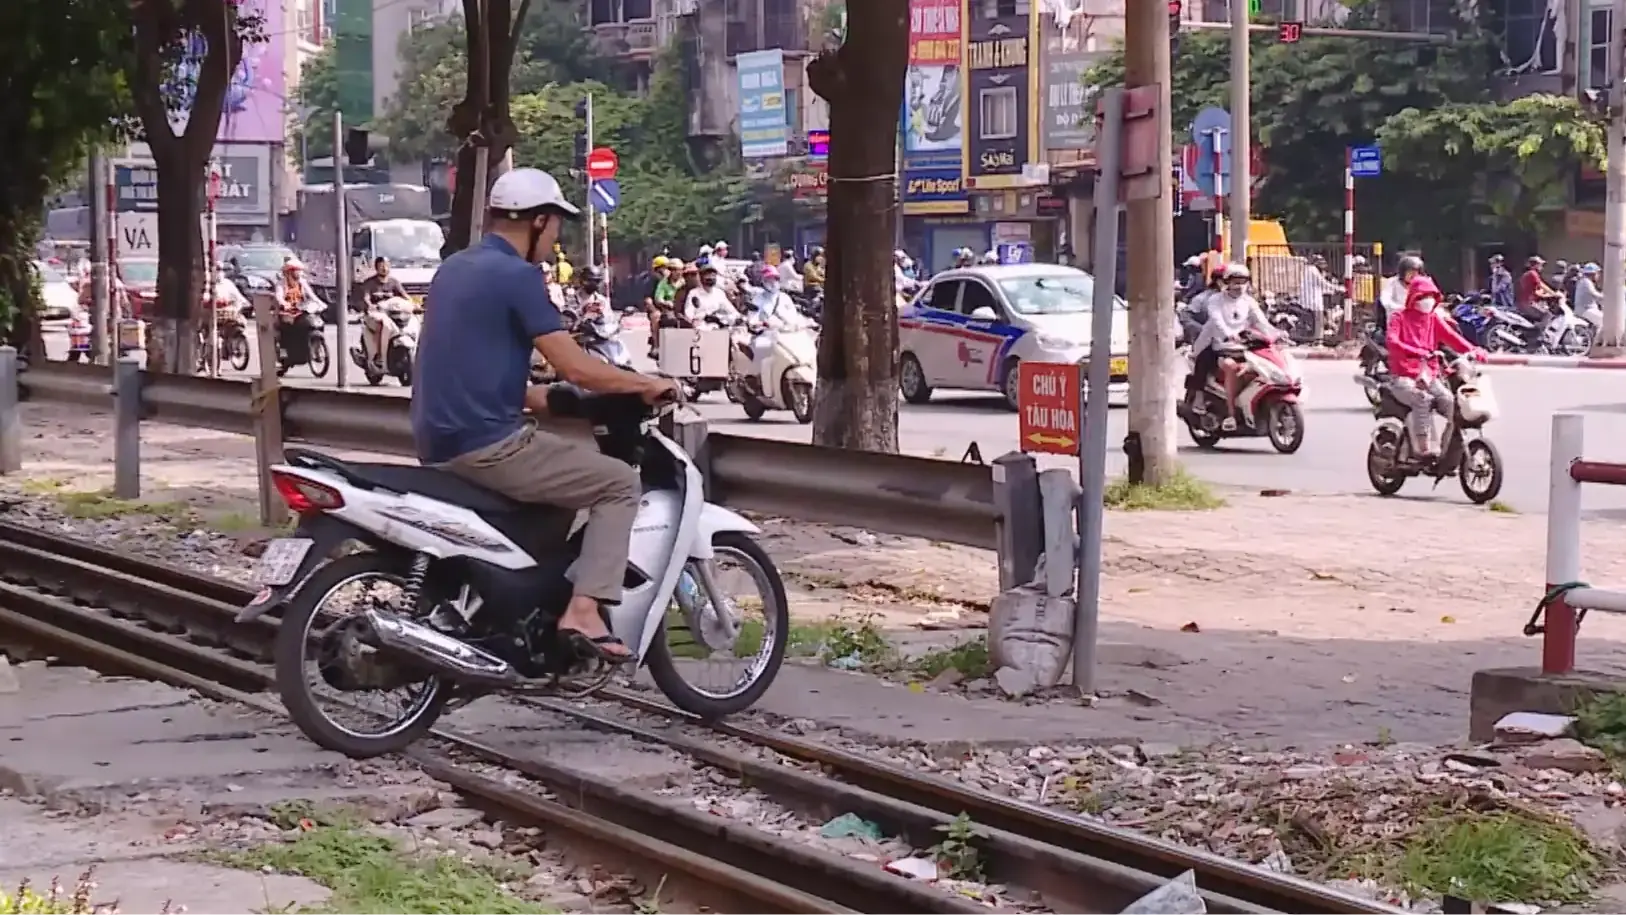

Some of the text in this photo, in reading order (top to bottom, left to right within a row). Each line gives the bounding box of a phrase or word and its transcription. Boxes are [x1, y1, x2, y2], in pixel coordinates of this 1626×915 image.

[1281, 24, 1299, 41] 30
[124, 217, 152, 250] VÁ
[689, 345, 702, 375] 6
[1032, 370, 1067, 398] CHÚ Ý
[1051, 400, 1076, 432] HỎA
